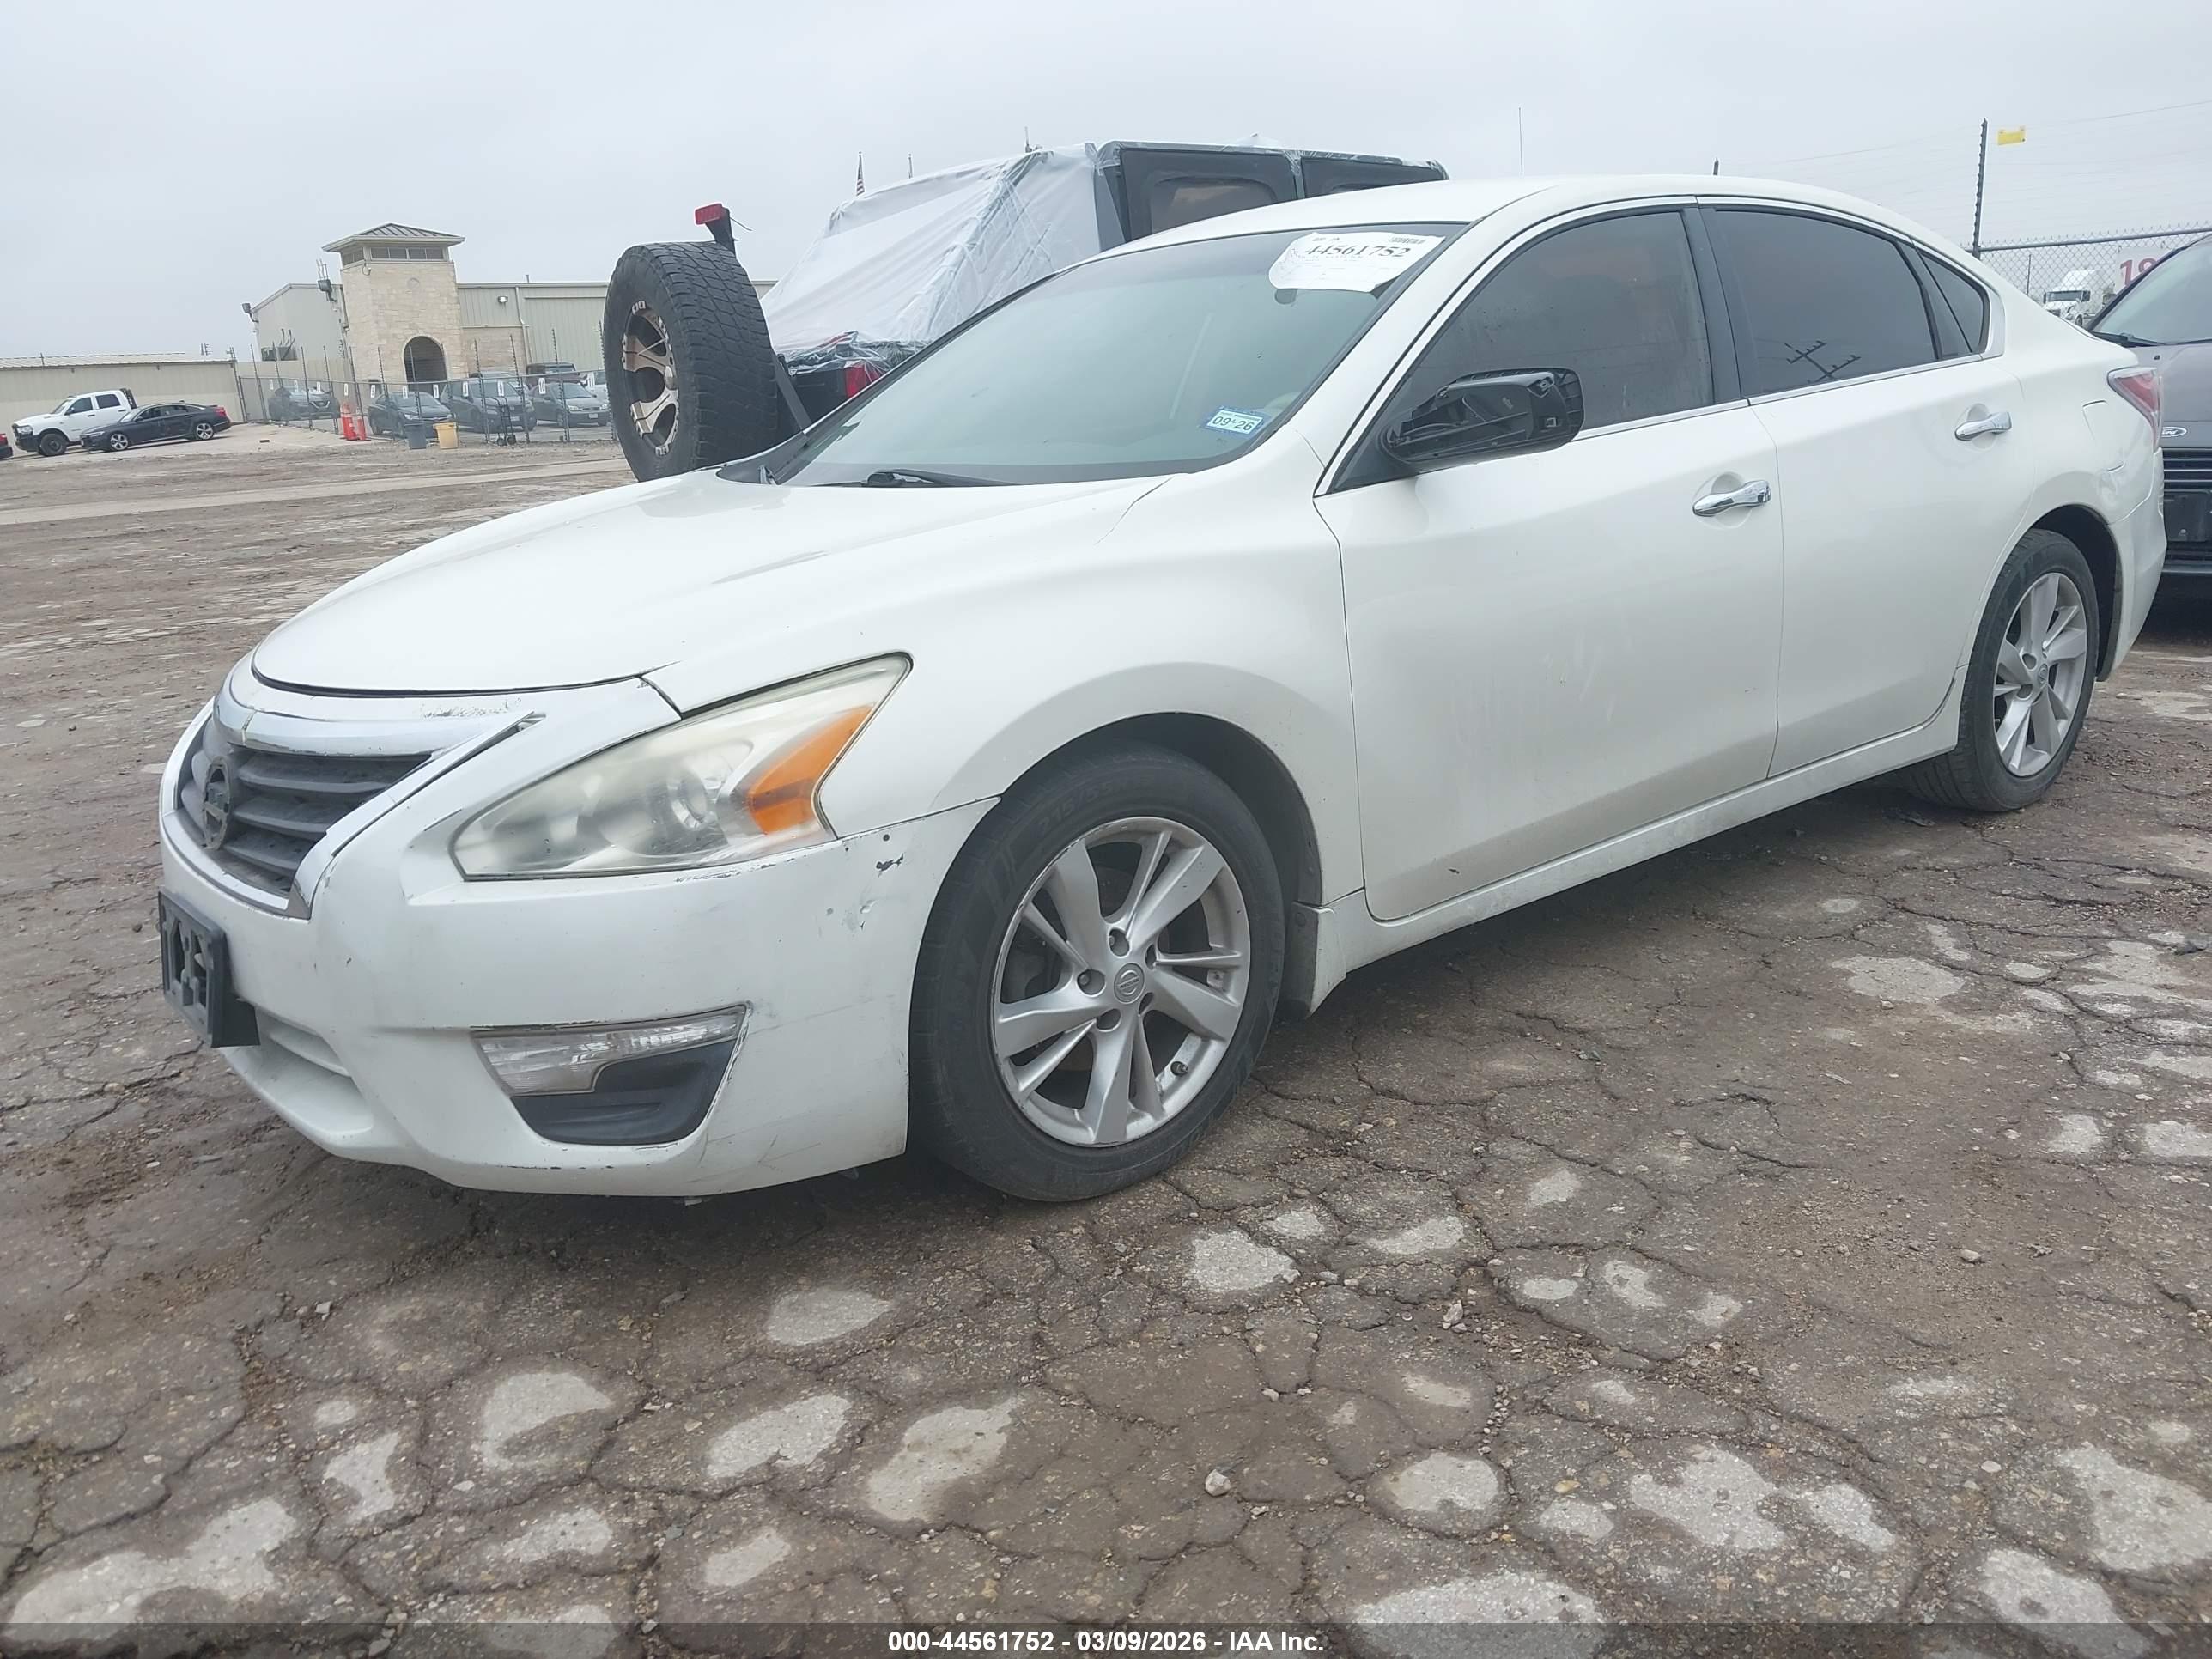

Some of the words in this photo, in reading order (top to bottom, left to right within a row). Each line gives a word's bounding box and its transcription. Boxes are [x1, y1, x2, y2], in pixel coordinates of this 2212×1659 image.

[1305, 245, 1411, 258] 44561752
[1212, 416, 1232, 427] 09
[1234, 420, 1255, 431] 26
